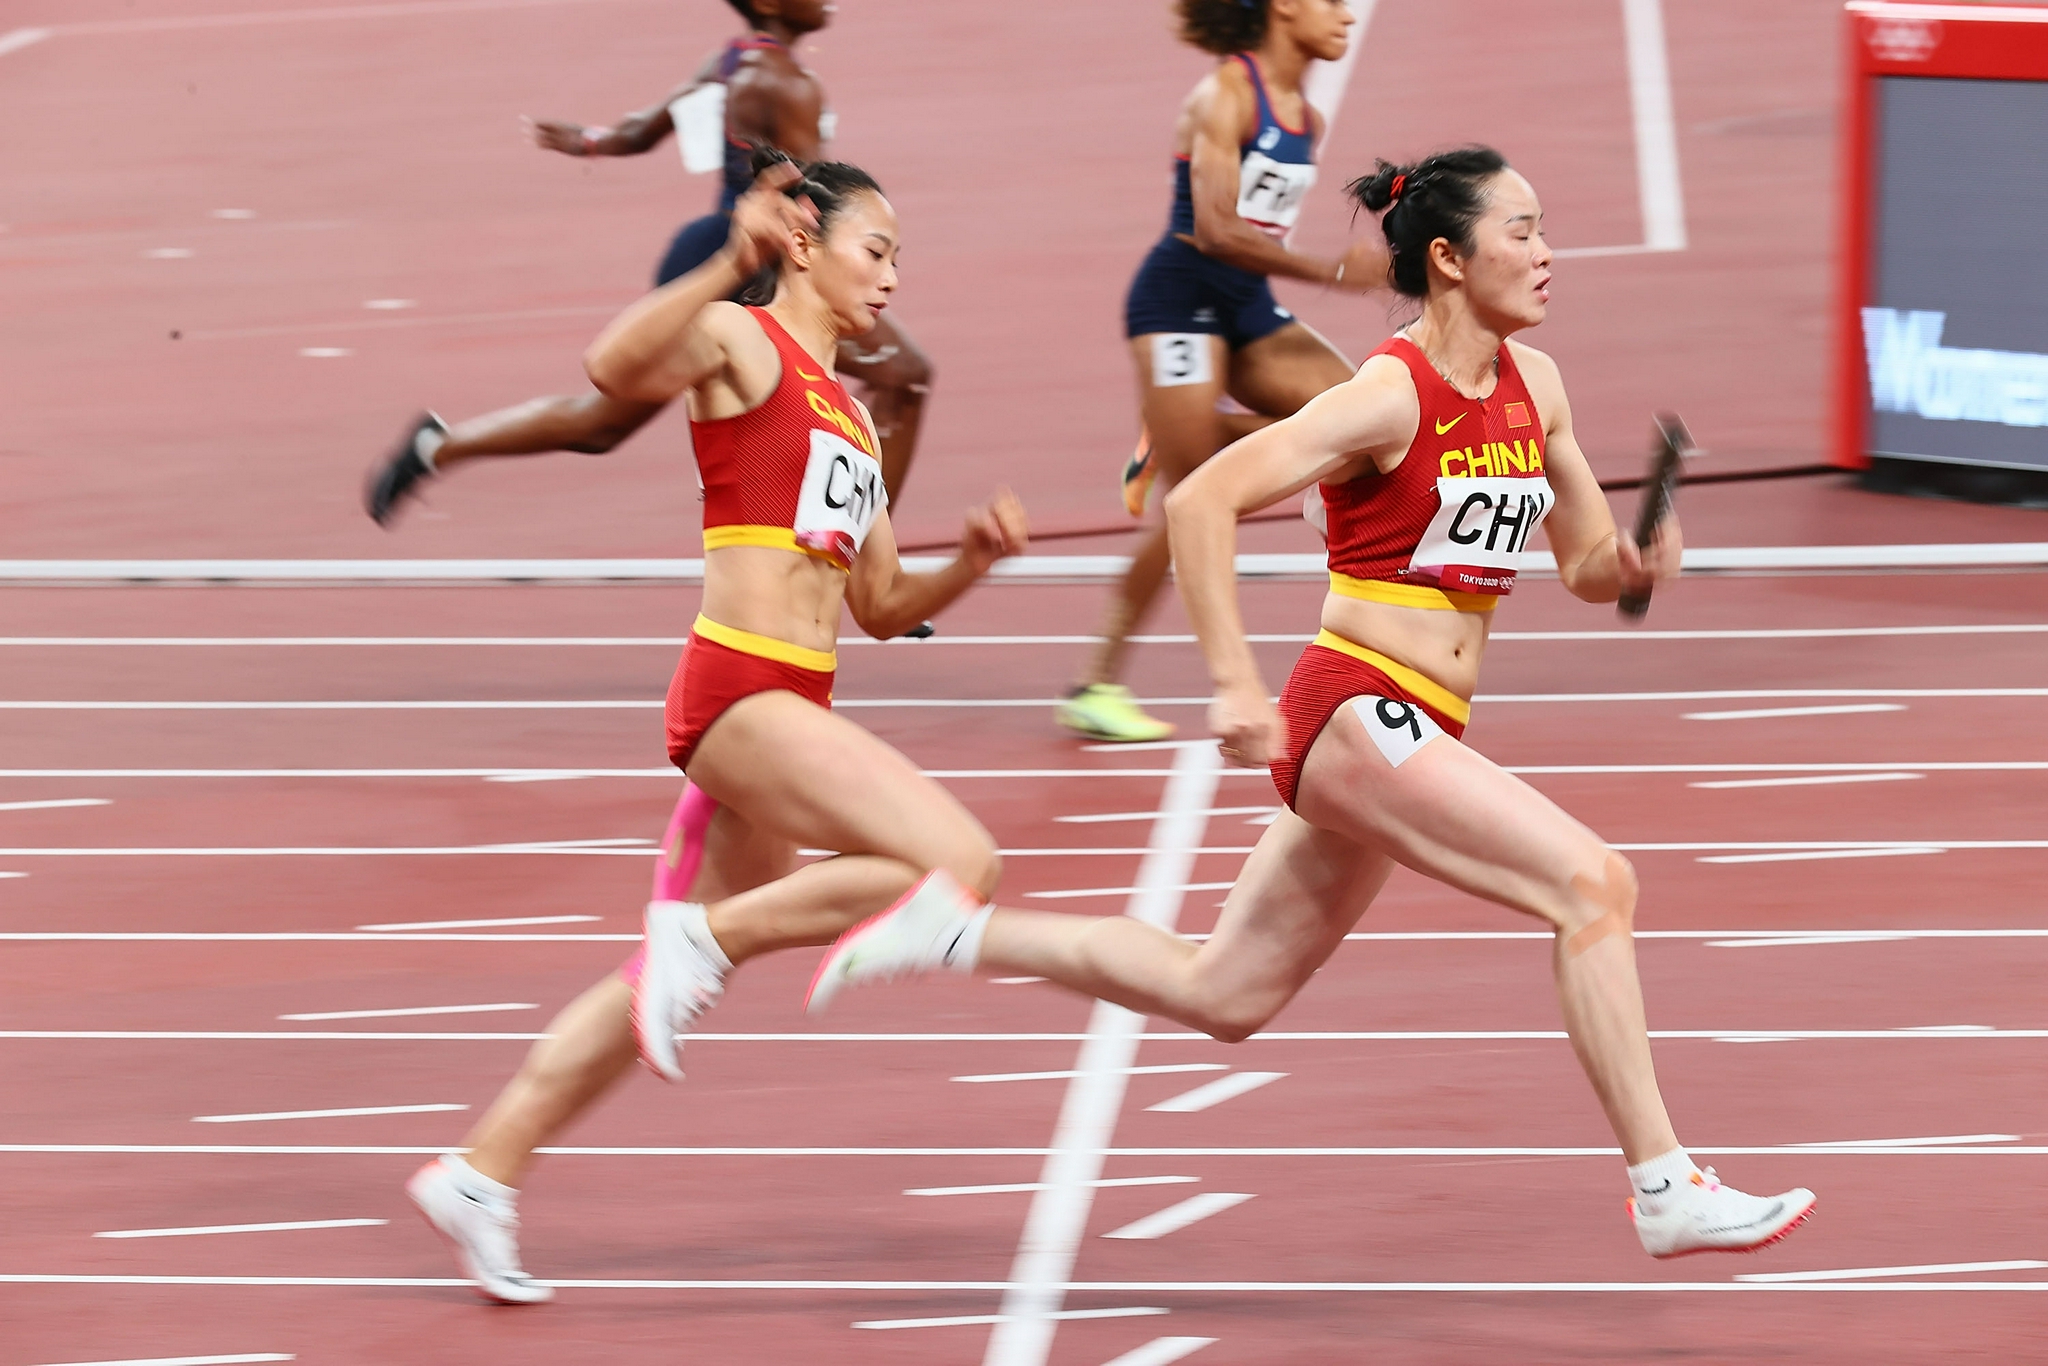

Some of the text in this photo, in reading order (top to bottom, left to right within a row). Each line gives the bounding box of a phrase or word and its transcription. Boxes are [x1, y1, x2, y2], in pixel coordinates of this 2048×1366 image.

[1166, 340, 1197, 377] 3
[1440, 438, 1543, 478] CHINA
[1448, 491, 1545, 553] CHN
[1375, 697, 1422, 742] 9
